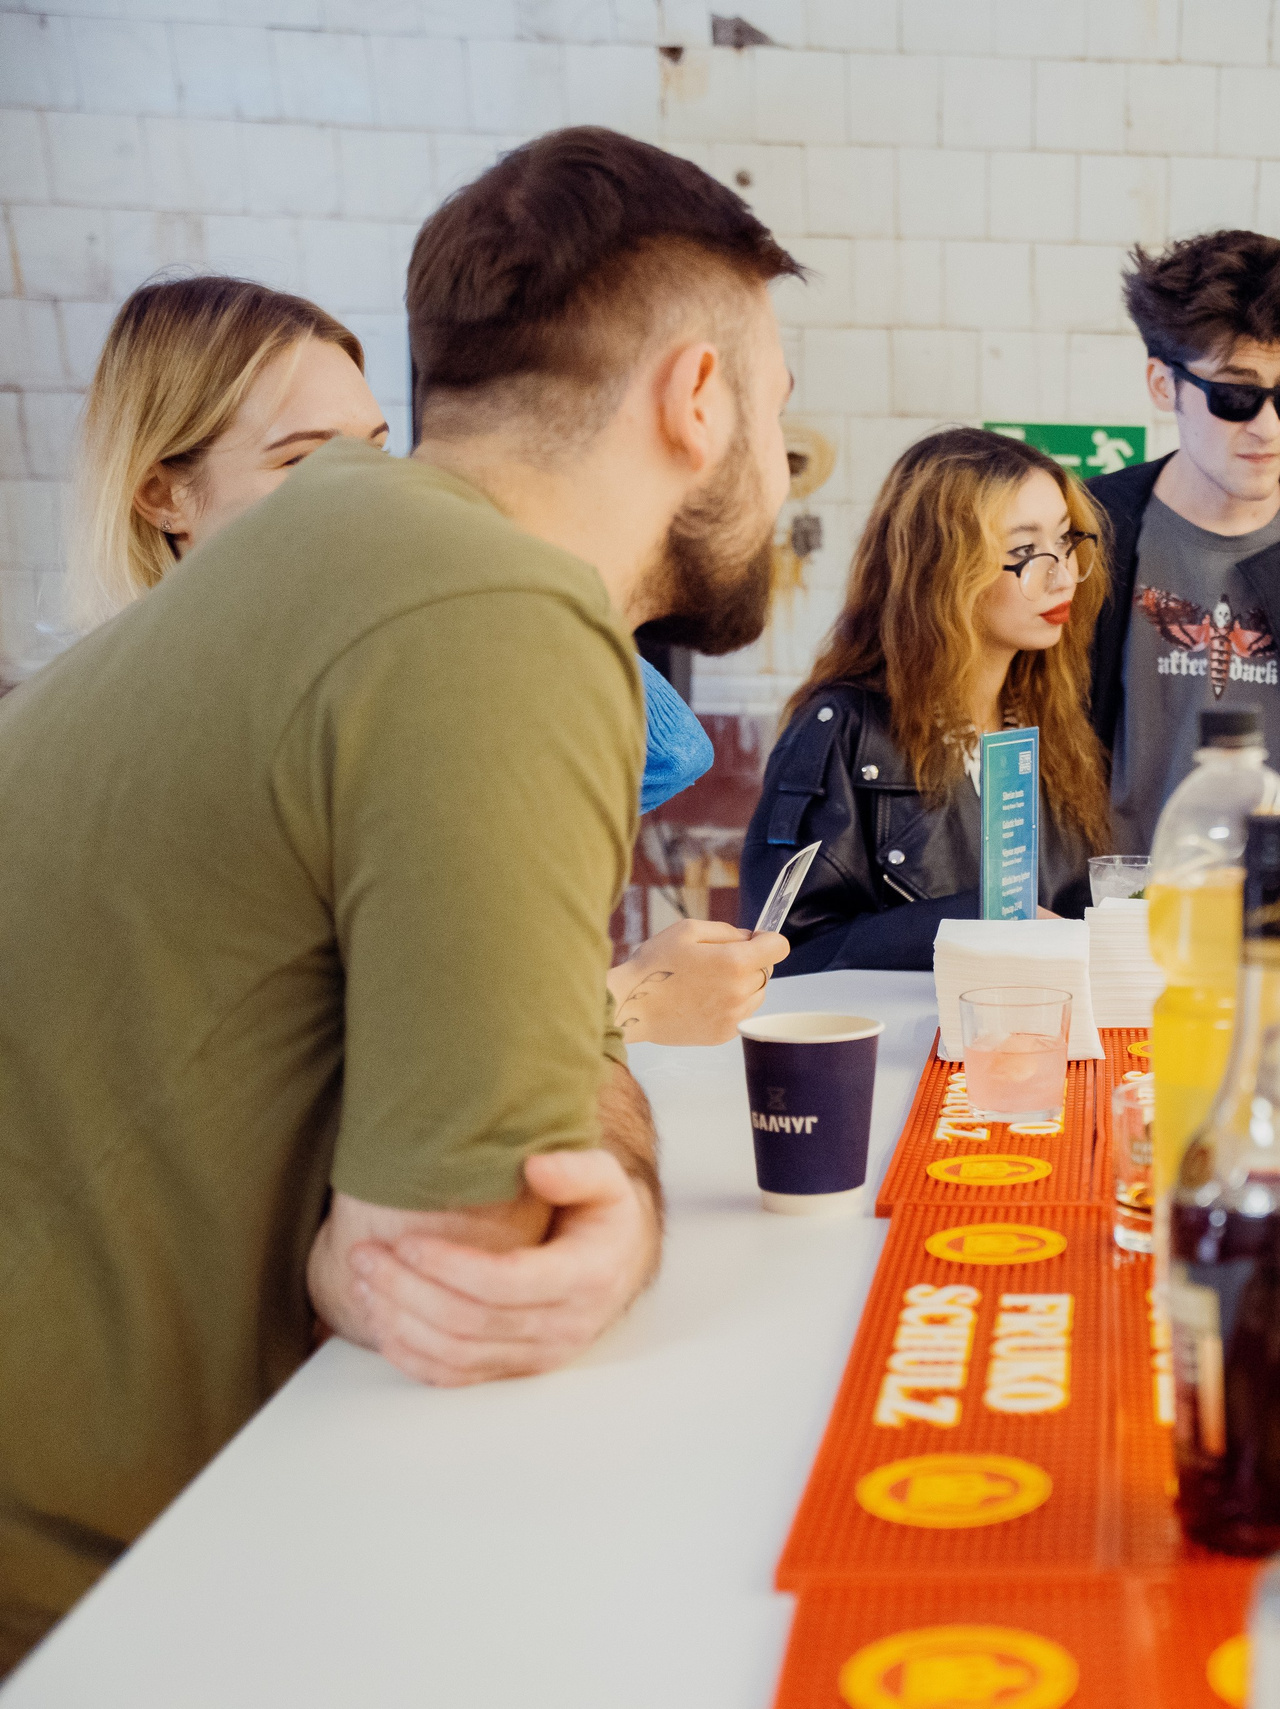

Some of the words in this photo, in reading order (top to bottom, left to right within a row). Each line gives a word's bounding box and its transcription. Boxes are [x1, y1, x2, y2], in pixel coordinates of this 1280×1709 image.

[1157, 650, 1208, 676] after
[1229, 656, 1278, 685] dark
[751, 1111, 819, 1135] БАЛЧУГ
[875, 1284, 982, 1428] SCHULZ
[984, 1292, 1074, 1414] FRUKO
